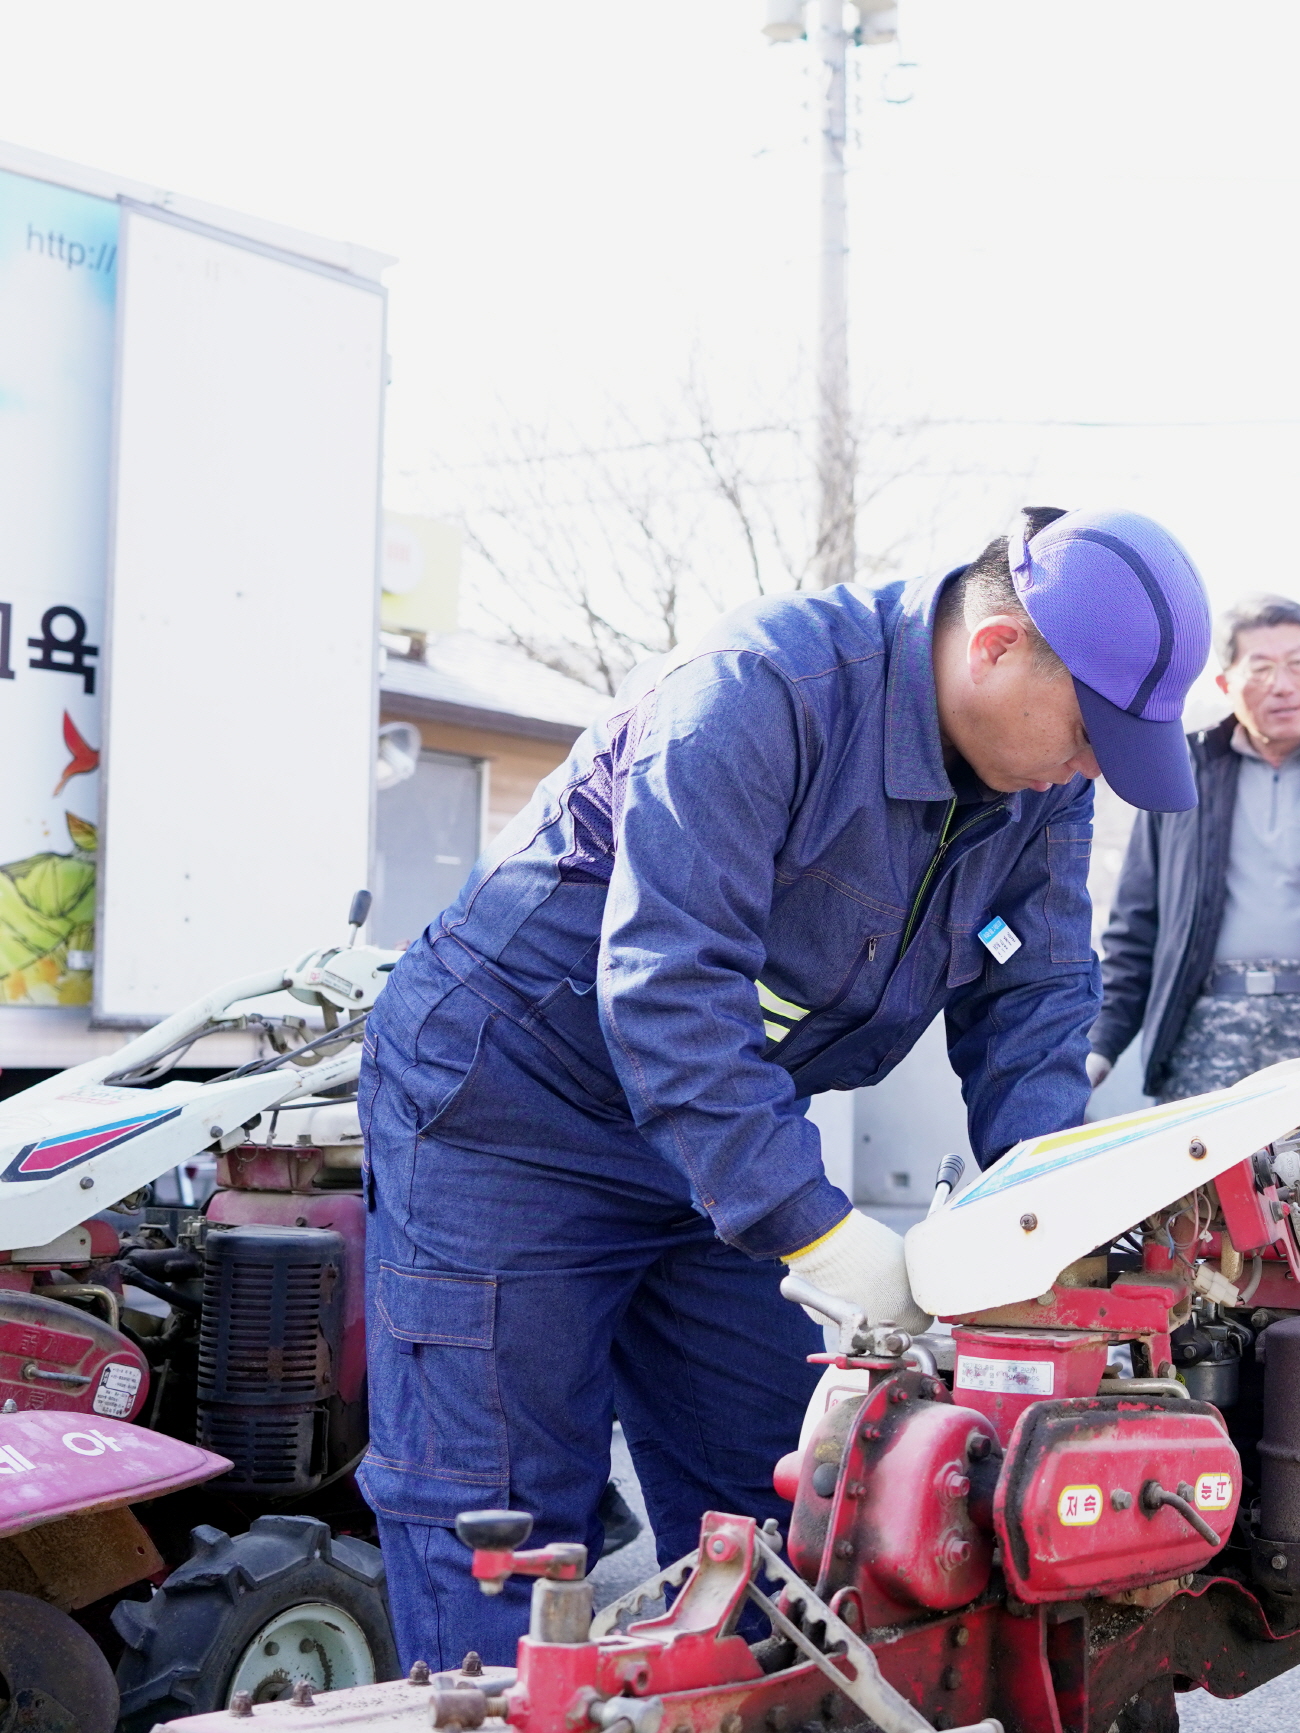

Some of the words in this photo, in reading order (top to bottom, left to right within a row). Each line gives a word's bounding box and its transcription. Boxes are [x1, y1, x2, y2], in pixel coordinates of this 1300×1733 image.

[27, 222, 117, 273] http://
[0, 602, 99, 695] 육
[1066, 1495, 1096, 1516] 저속
